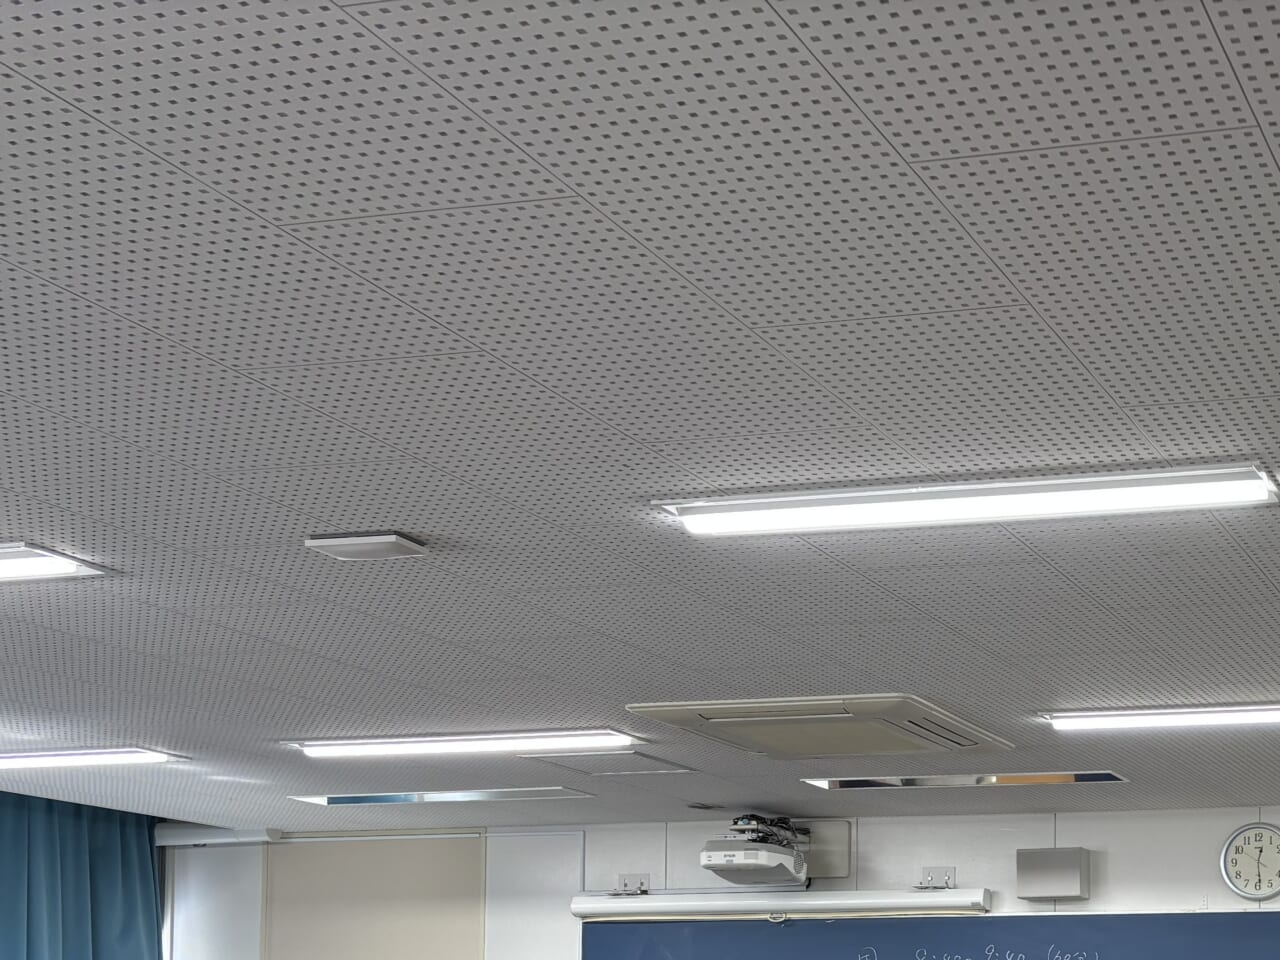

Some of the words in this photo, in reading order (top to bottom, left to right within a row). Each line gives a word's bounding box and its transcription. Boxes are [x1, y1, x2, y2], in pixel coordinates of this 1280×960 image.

[1244, 836, 1250, 846] 11
[1254, 832, 1263, 842] 12
[1269, 836, 1273, 845] 1
[1234, 844, 1244, 854] 10
[1231, 858, 1238, 867] 9
[1235, 870, 1242, 880] 8
[1276, 870, 1280, 878] 4
[1244, 878, 1250, 888] 7
[1254, 882, 1262, 891] 6
[1266, 879, 1273, 888] 5
